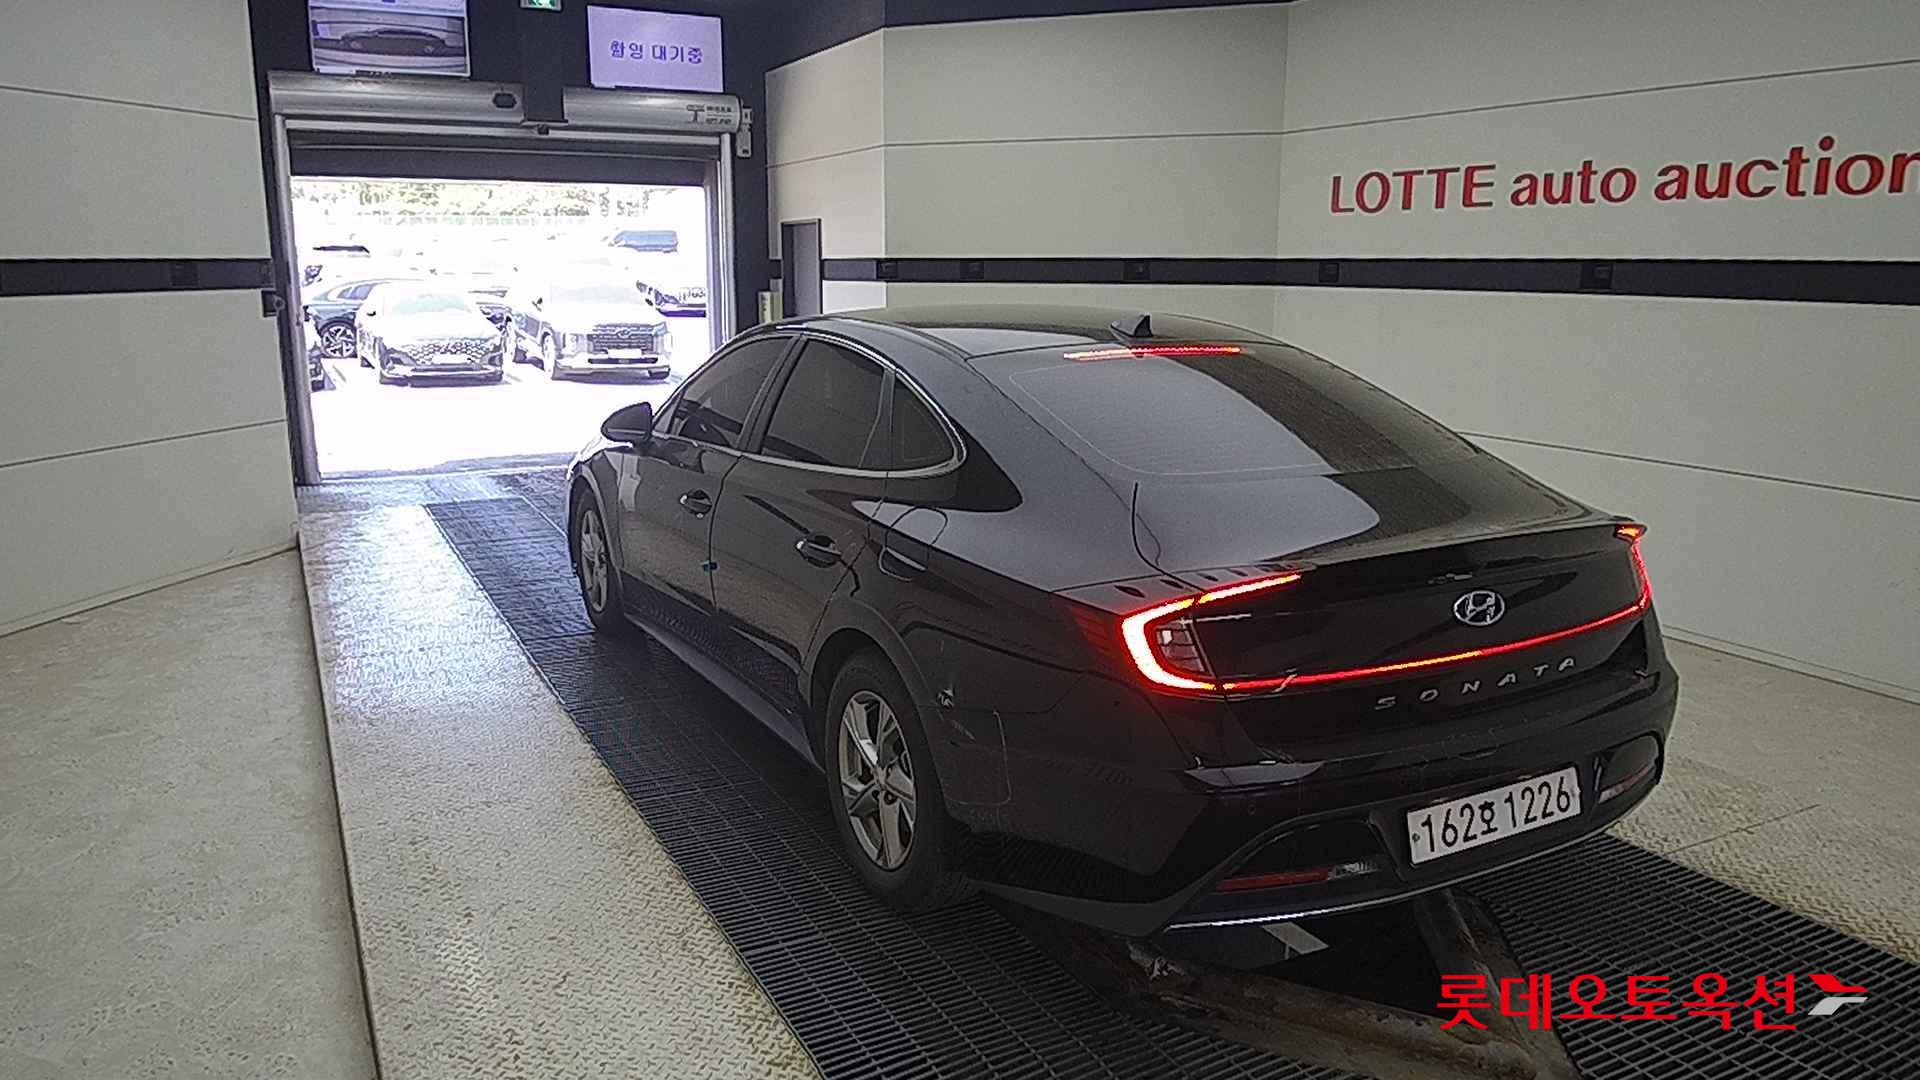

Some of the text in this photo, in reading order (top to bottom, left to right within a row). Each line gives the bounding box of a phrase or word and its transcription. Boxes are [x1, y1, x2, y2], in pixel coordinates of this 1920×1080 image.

[652, 44, 703, 65] 대기중
[1329, 164, 1497, 214] LOTTE
[1509, 159, 1638, 207] auto
[1374, 657, 1577, 711] SONATA
[1421, 776, 1572, 853] 162호 1226
